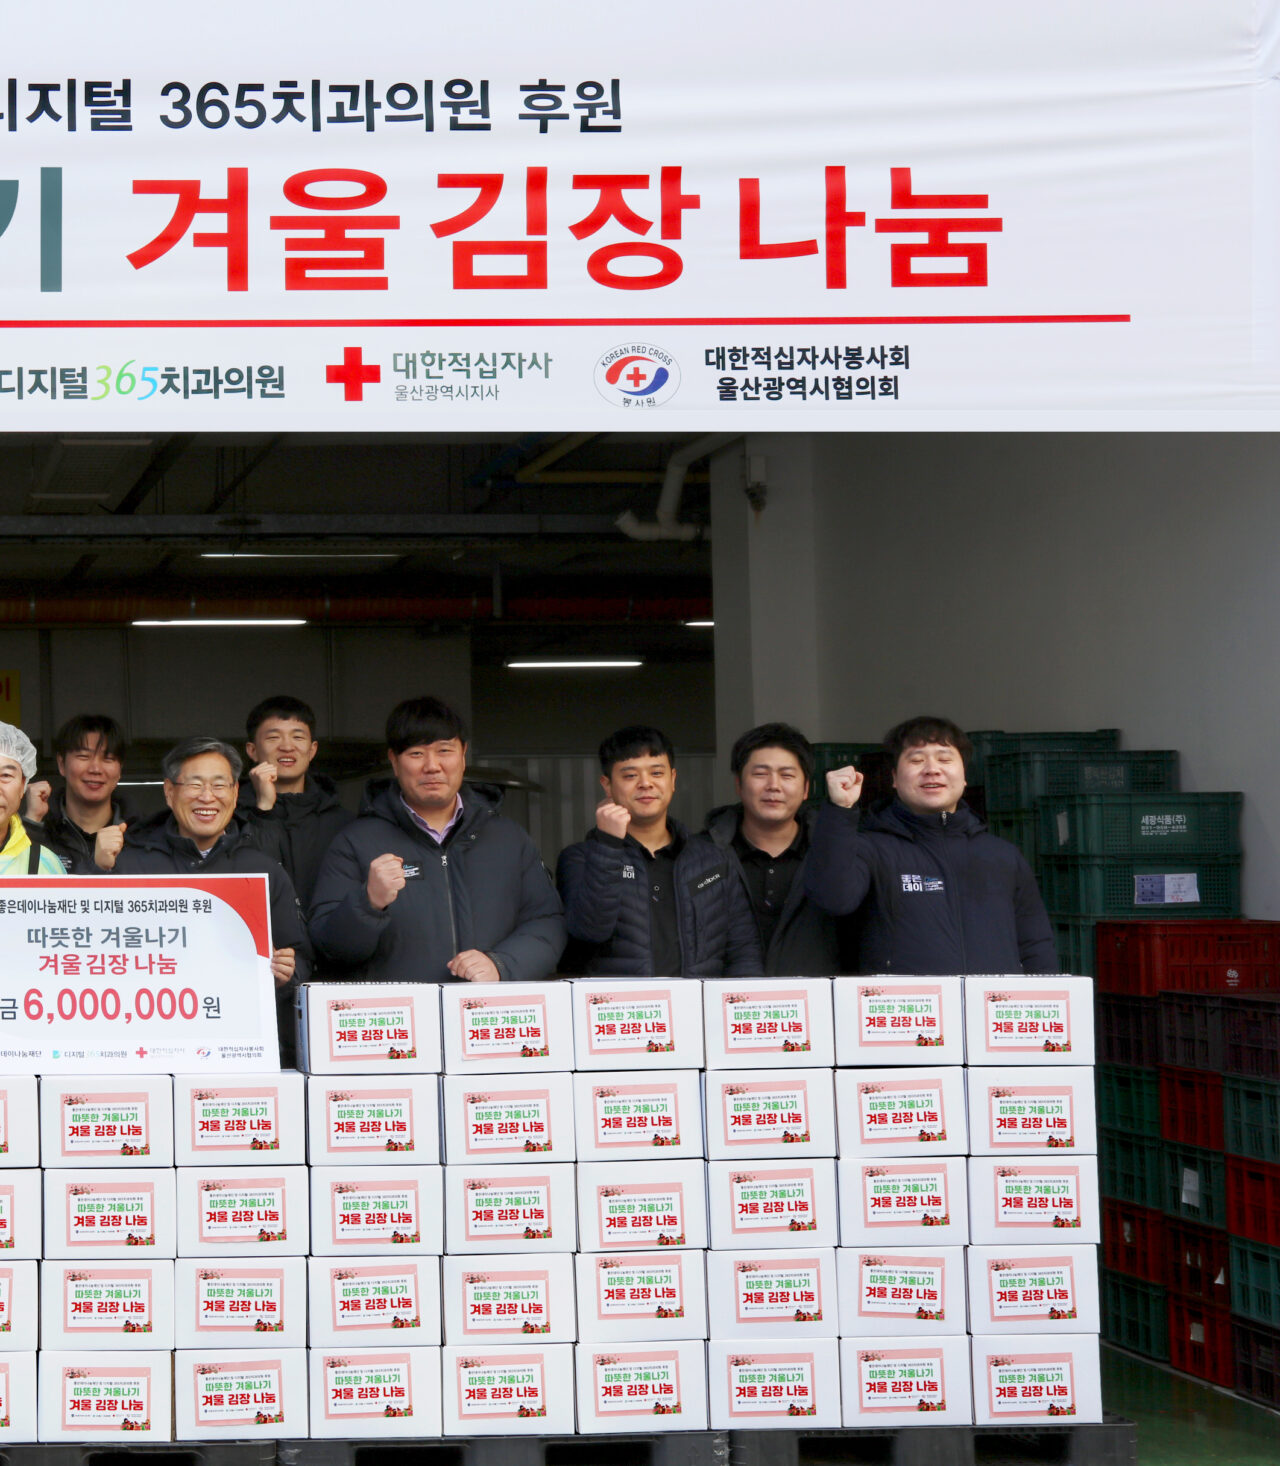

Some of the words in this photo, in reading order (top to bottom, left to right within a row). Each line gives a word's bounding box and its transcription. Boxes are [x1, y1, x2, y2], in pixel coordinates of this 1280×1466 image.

[160, 79, 491, 132] 365치과의원
[519, 78, 622, 134] 후원
[126, 167, 400, 292] 겨울
[430, 166, 700, 290] 김장
[739, 165, 1003, 289] 나눔
[601, 346, 629, 367] KOREAN
[631, 345, 647, 354] RED
[648, 347, 673, 366] CROSS
[705, 345, 910, 371] 대한적십자사봉사회
[393, 350, 552, 379] 대한적십자사
[394, 384, 499, 402] 울산광역시지사
[717, 374, 898, 402] 울산광역시협의회
[80, 899, 91, 914] 및
[93, 899, 124, 914] 디지털
[127, 898, 189, 914] 365치과의원
[192, 898, 213, 914] 후원
[27, 926, 94, 949] 따뜻한
[100, 925, 188, 949] 겨울나기
[38, 953, 83, 976] 겨울
[86, 953, 130, 976] 김장
[134, 952, 178, 976] 나눔
[869, 1003, 895, 1014] 따뜻한
[338, 1017, 367, 1028] 따뜻한
[865, 1016, 887, 1027] 겨울
[890, 1016, 913, 1027] 김장
[915, 1015, 937, 1027] 나눔
[335, 1029, 358, 1041] 겨울
[361, 1029, 384, 1040] 김장
[386, 1028, 409, 1039] 나눔
[604, 1104, 631, 1115] 따뜻한
[71, 1112, 100, 1123] 따뜻한
[601, 1116, 623, 1128] 겨울
[626, 1116, 649, 1127] 김장
[650, 1115, 673, 1126] 나눔
[68, 1124, 91, 1136] 겨울
[94, 1124, 118, 1136] 김장
[120, 1124, 143, 1135] 나눔
[999, 1278, 1027, 1289] 따뜻한
[207, 1287, 235, 1299] 따뜻한
[996, 1290, 1019, 1302] 겨울
[1022, 1289, 1044, 1301] 김장
[1046, 1288, 1069, 1299] 나눔
[203, 1300, 225, 1311] 겨울
[229, 1300, 252, 1311] 김장
[254, 1300, 277, 1312] 나눔
[604, 1372, 633, 1383] 따뜻한
[601, 1384, 624, 1396] 겨울
[627, 1384, 649, 1396] 김장
[651, 1383, 674, 1394] 나눔
